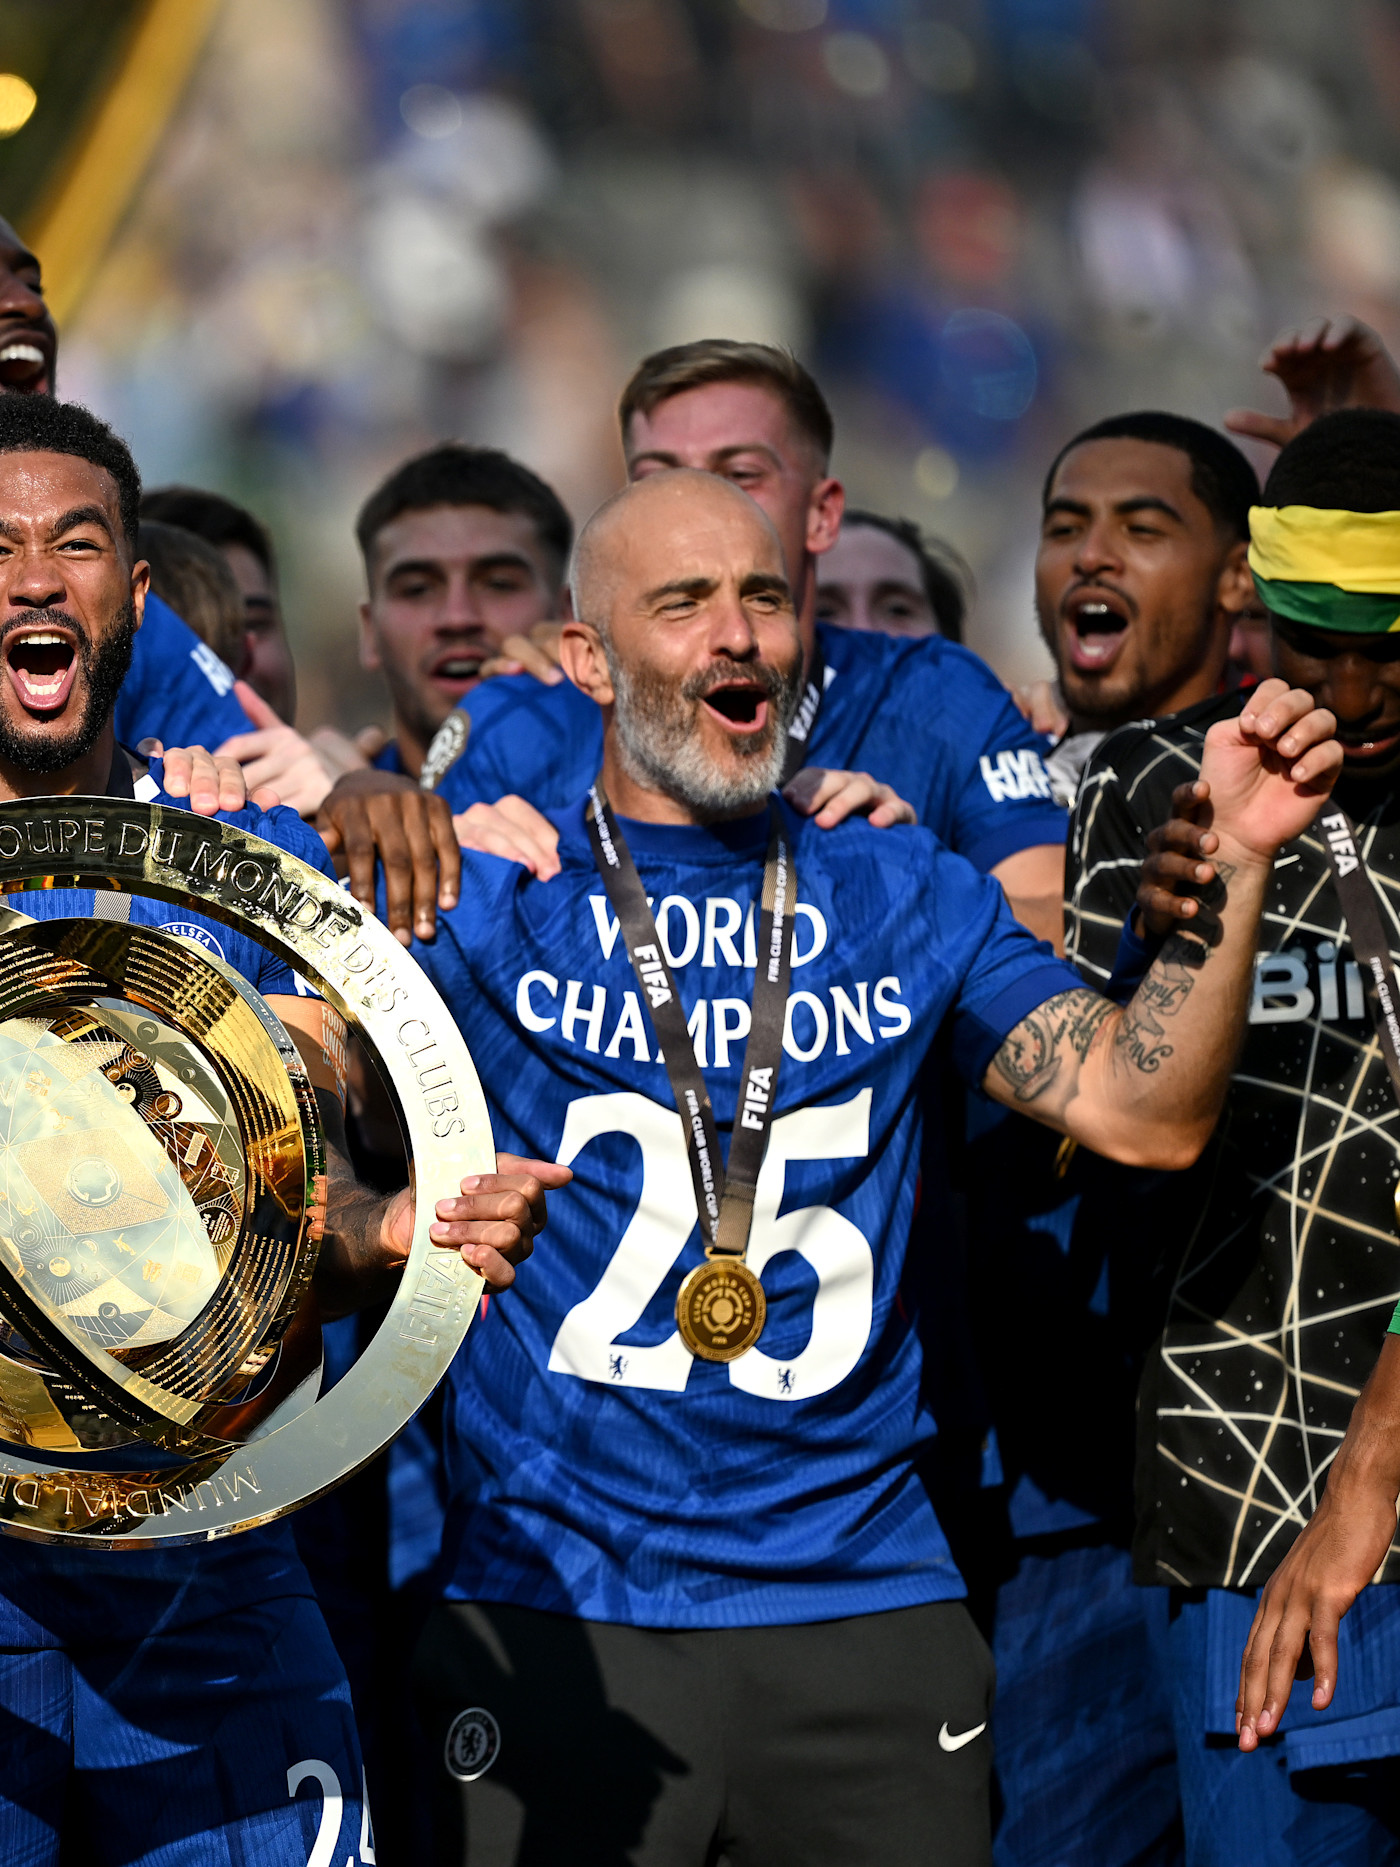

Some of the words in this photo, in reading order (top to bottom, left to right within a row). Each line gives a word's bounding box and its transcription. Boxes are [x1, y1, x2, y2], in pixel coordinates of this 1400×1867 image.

[984, 773, 1053, 803] NAT
[1321, 812, 1359, 878] FIFA
[164, 925, 211, 947] ELSEA
[588, 895, 828, 967] WORLD
[118, 821, 182, 865] DU
[190, 840, 351, 950] MONDE
[396, 1018, 466, 1140] CLUBS
[634, 943, 673, 1009] FIFA
[321, 1005, 348, 1041] FOOTB
[516, 969, 912, 1067] CHAMPONS
[741, 1067, 774, 1131] FIFA
[692, 1116, 707, 1148] CLUB
[698, 1147, 714, 1193] WORLD
[548, 1087, 874, 1401] 25
[399, 1249, 465, 1345] FIFA
[55, 1465, 262, 1518] MUNDIAL
